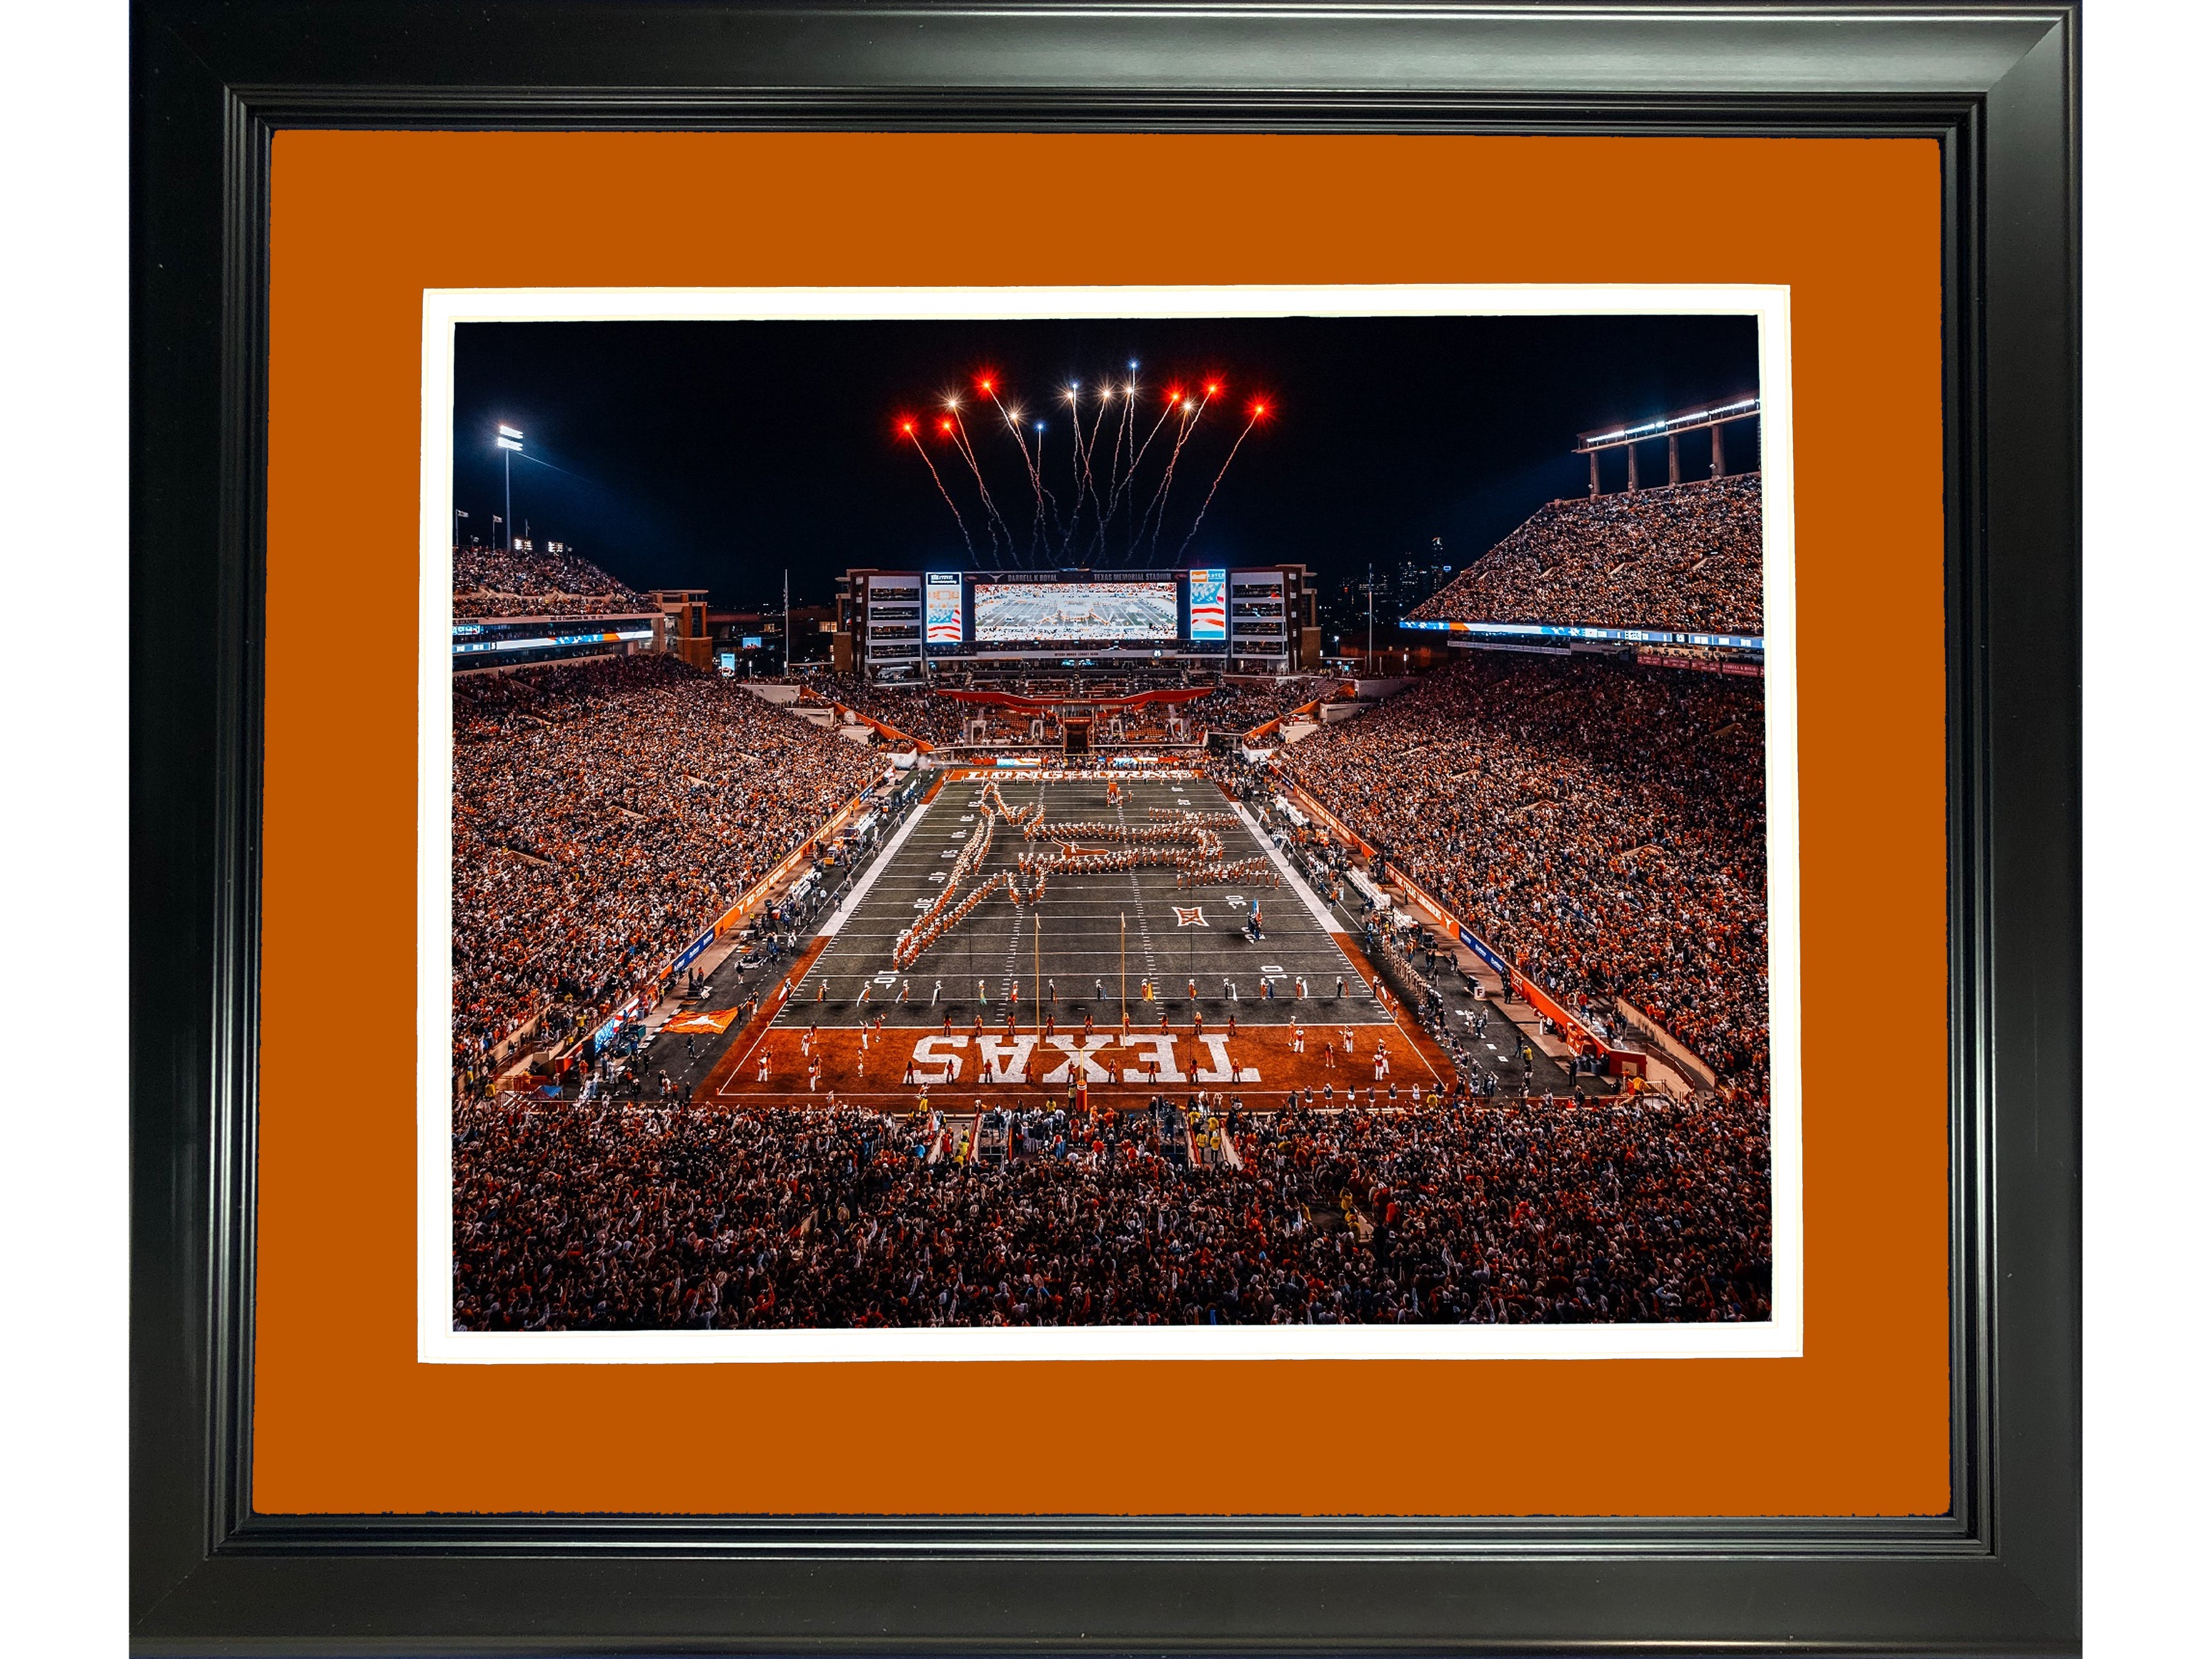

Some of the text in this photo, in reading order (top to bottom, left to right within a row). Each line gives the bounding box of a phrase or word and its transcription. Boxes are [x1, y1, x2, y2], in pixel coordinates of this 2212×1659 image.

[914, 898, 935, 908] 30
[1225, 895, 1247, 906] 30
[873, 970, 900, 984] 10
[1260, 965, 1288, 979] 10
[901, 1034, 1261, 1084] TEXAS
